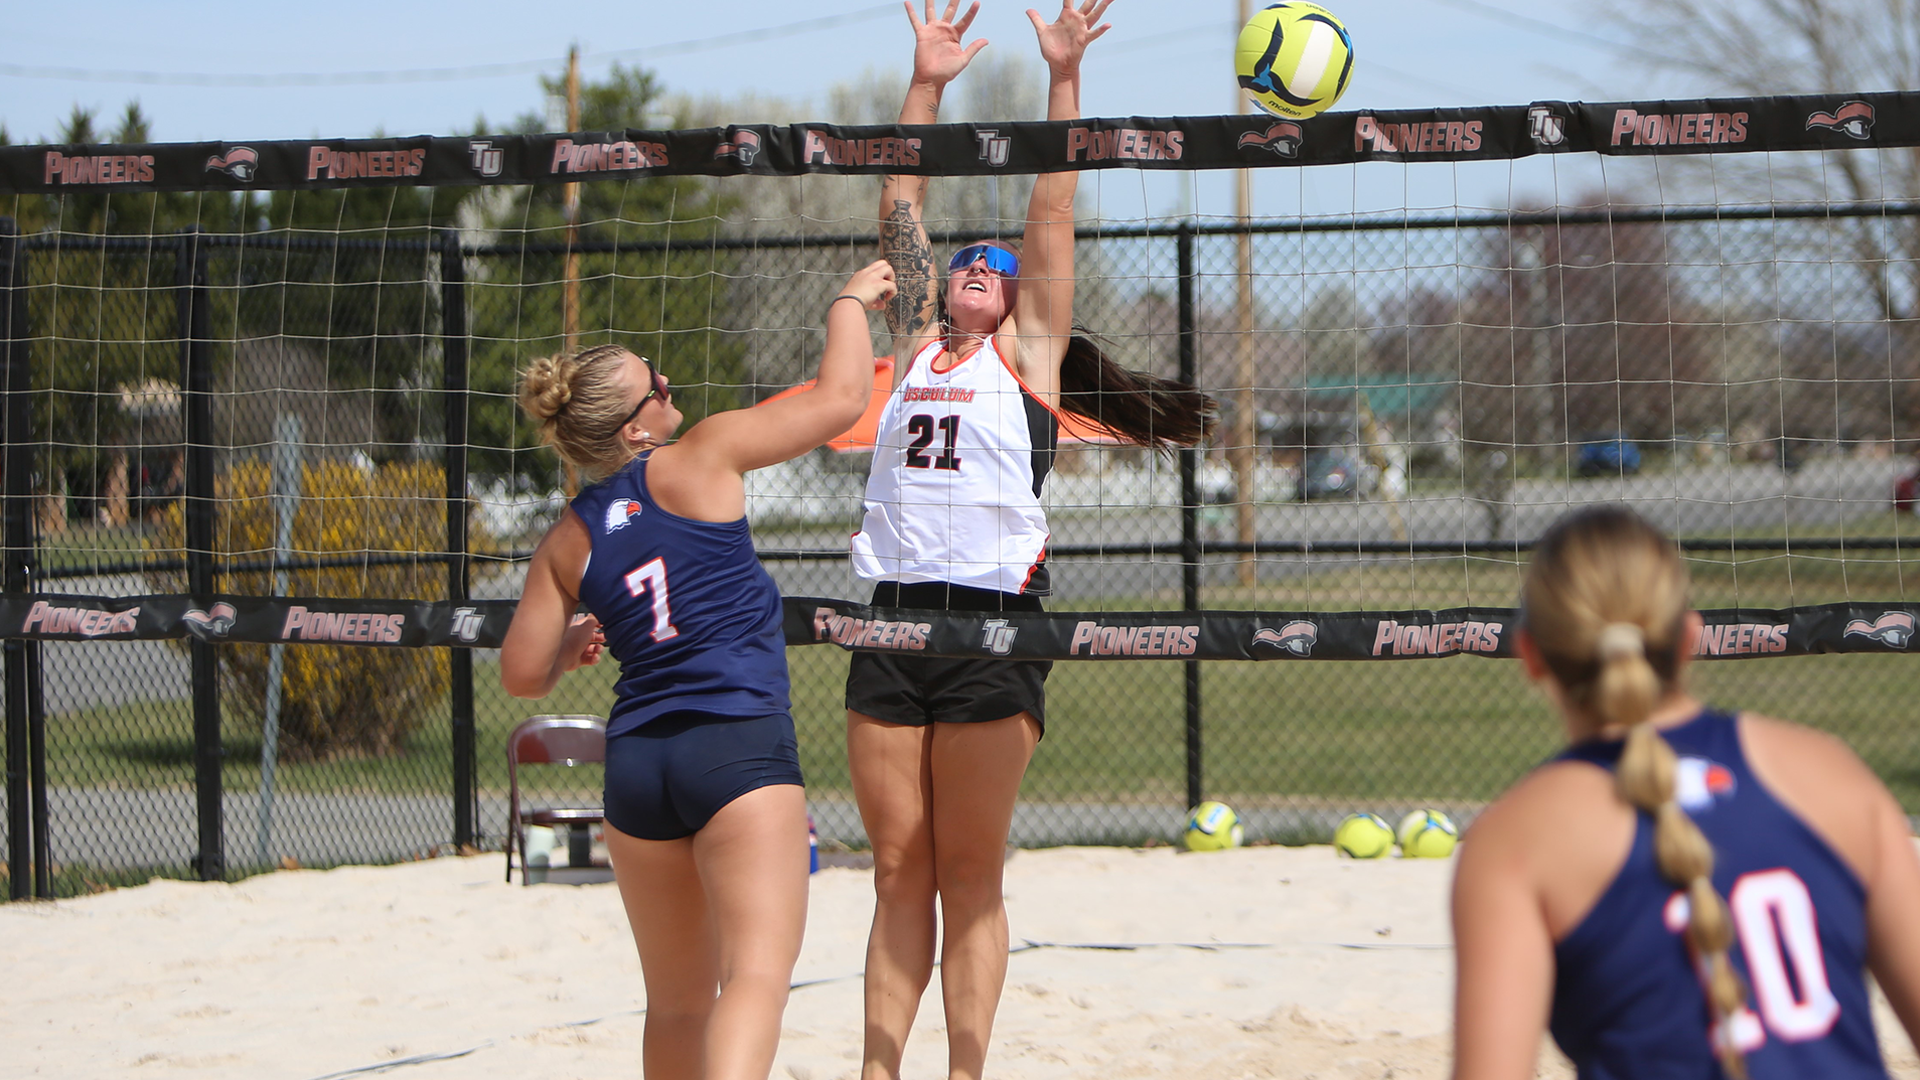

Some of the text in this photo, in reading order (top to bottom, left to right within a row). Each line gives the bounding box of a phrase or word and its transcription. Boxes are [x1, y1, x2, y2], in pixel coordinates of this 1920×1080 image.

[1268, 100, 1302, 117] molten
[44, 106, 1749, 185] PIONEERS PIONEERS TU PIONEERS PIONEERS TU PIONEERS PIONEERS TU PIONEERS
[905, 414, 962, 471] 21
[624, 556, 680, 643] 7
[22, 601, 141, 636] PIONEERS
[282, 606, 406, 642] PIONEERS
[451, 607, 486, 643] TU
[813, 607, 932, 650] PIONEERS
[982, 618, 1018, 656] TU
[1070, 621, 1200, 656] PIONEERS
[1372, 620, 1502, 656] PIONEERS
